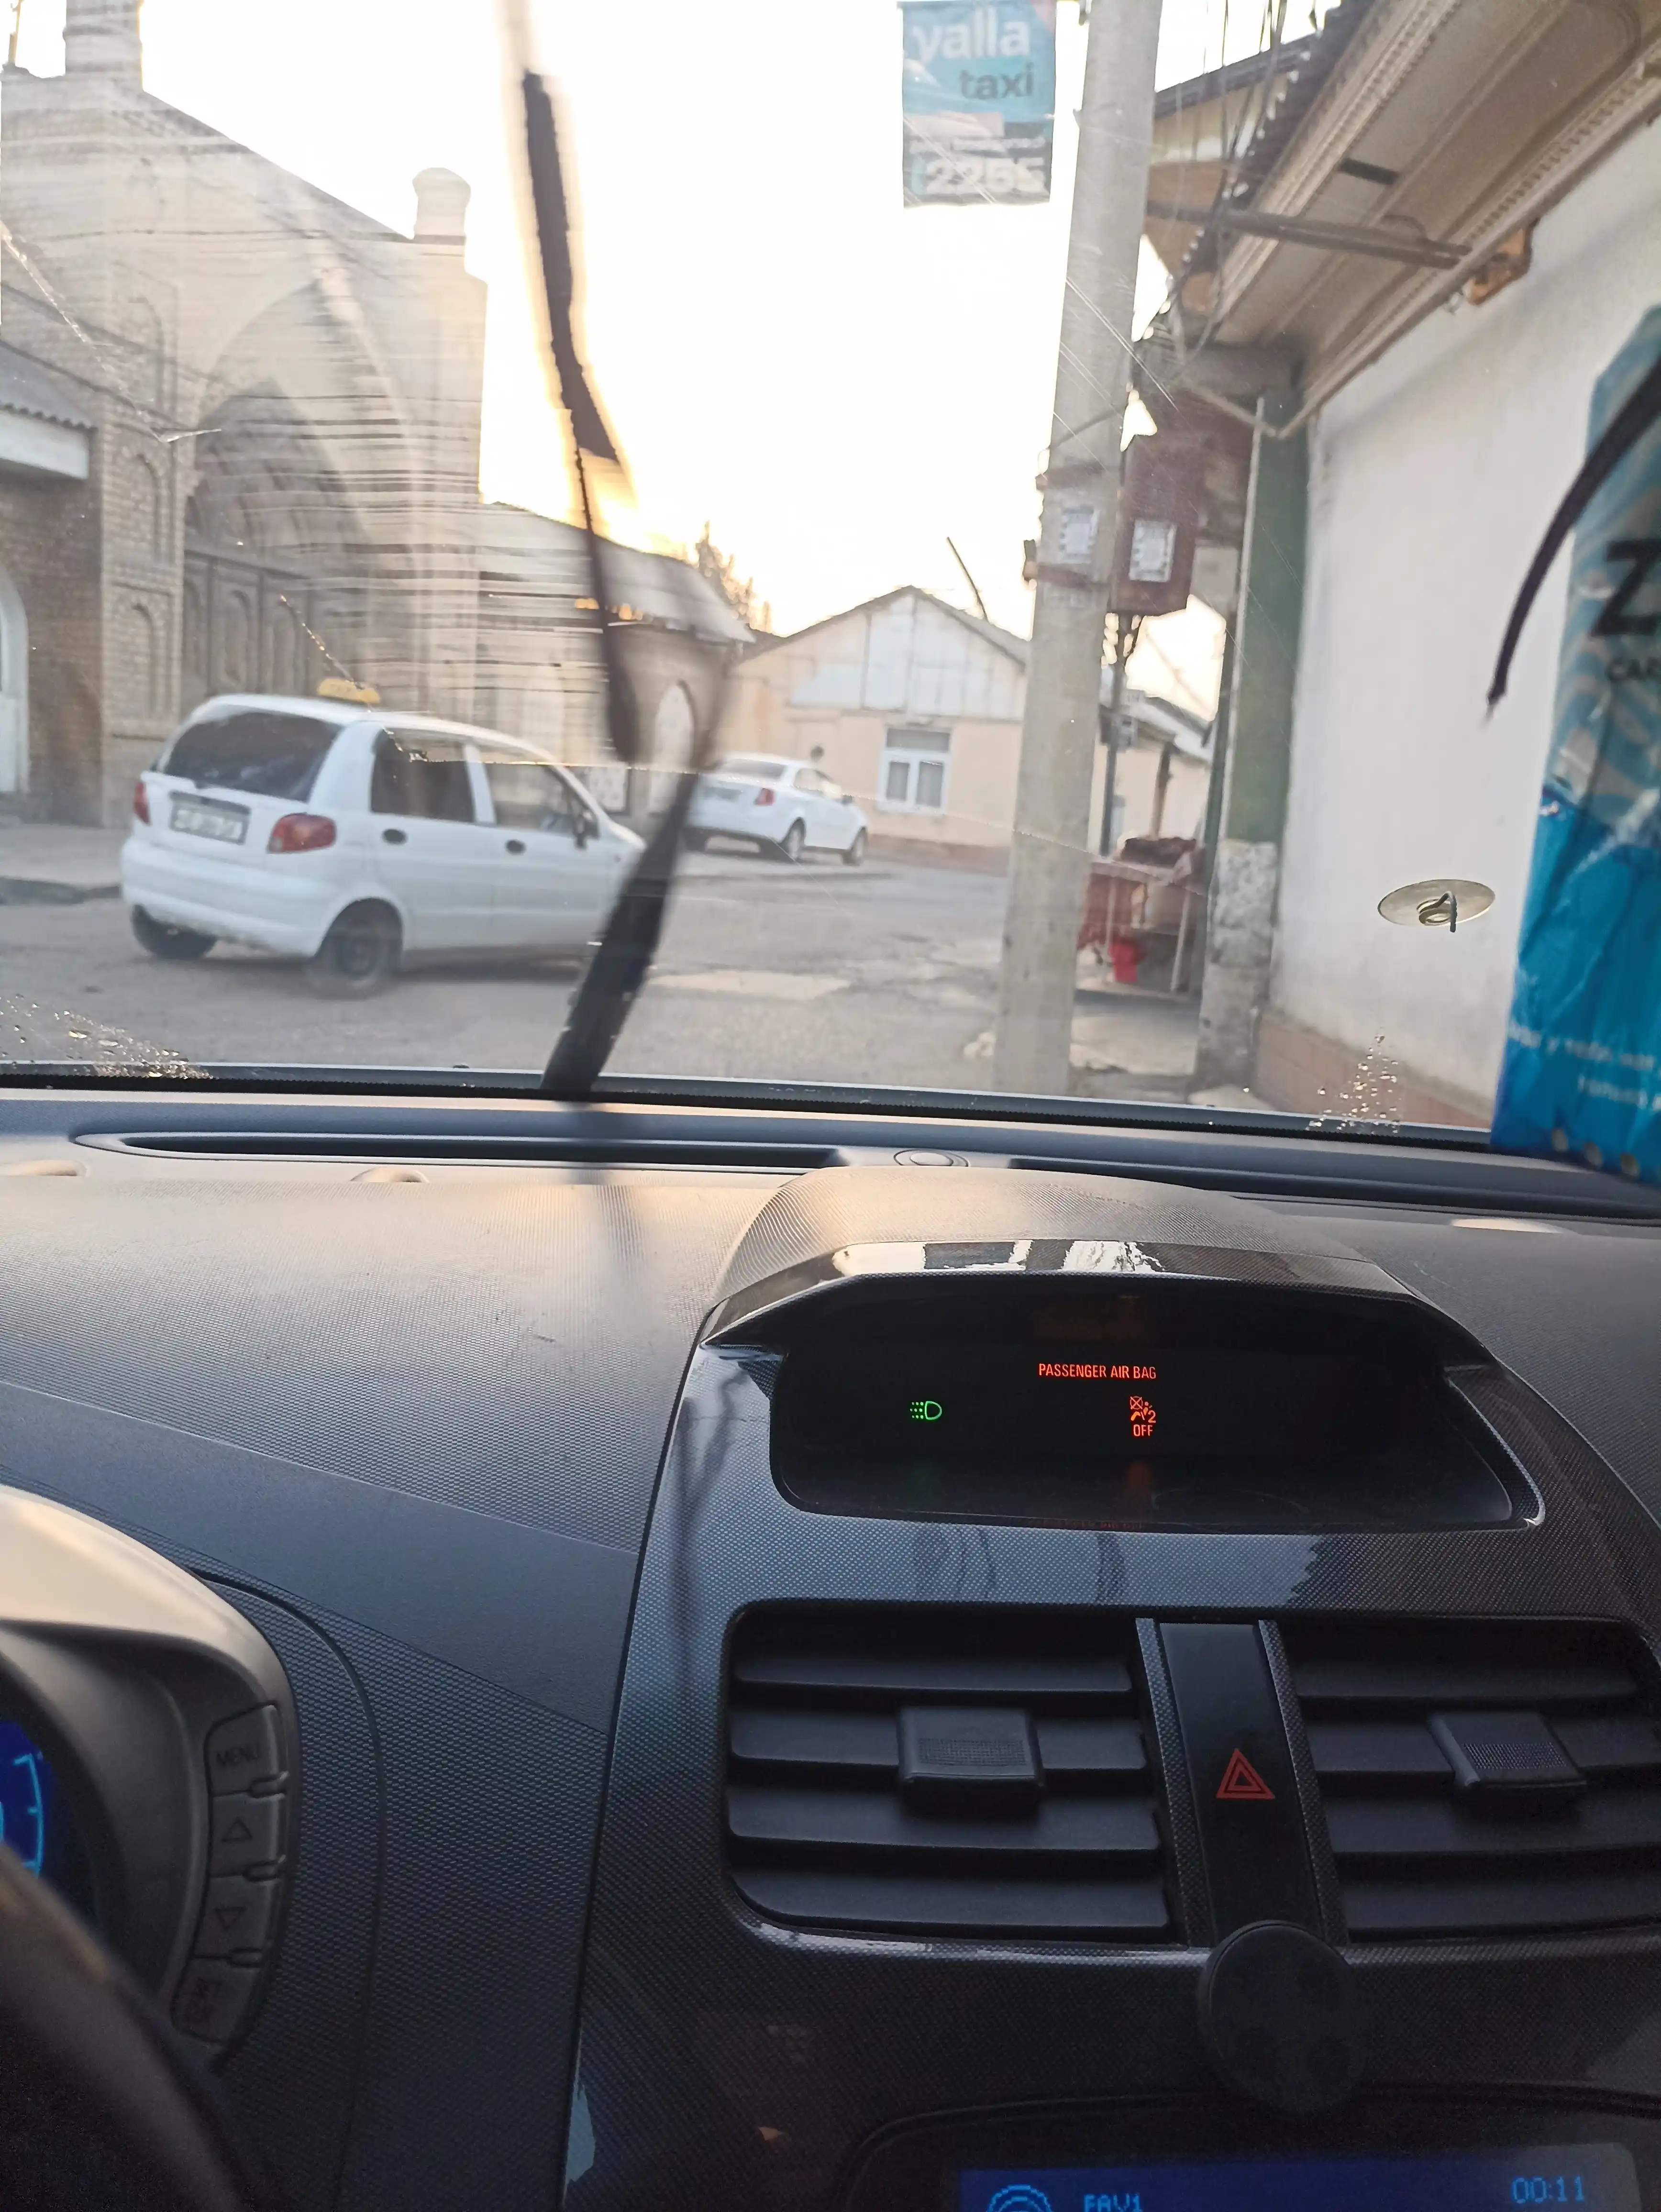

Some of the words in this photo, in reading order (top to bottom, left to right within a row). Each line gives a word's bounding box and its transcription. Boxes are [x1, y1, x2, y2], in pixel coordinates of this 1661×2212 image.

[912, 4, 1030, 66] yalla
[959, 62, 1034, 100] taxi
[1039, 1363, 1107, 1378] PASSENGER
[1110, 1366, 1129, 1379] AIR
[1133, 1366, 1157, 1380] BAG
[1133, 1424, 1153, 1437] OFF
[217, 1743, 259, 1766] MENU
[1512, 2176, 1583, 2204] 00:11
[1085, 2194, 1142, 2212] FAV1
